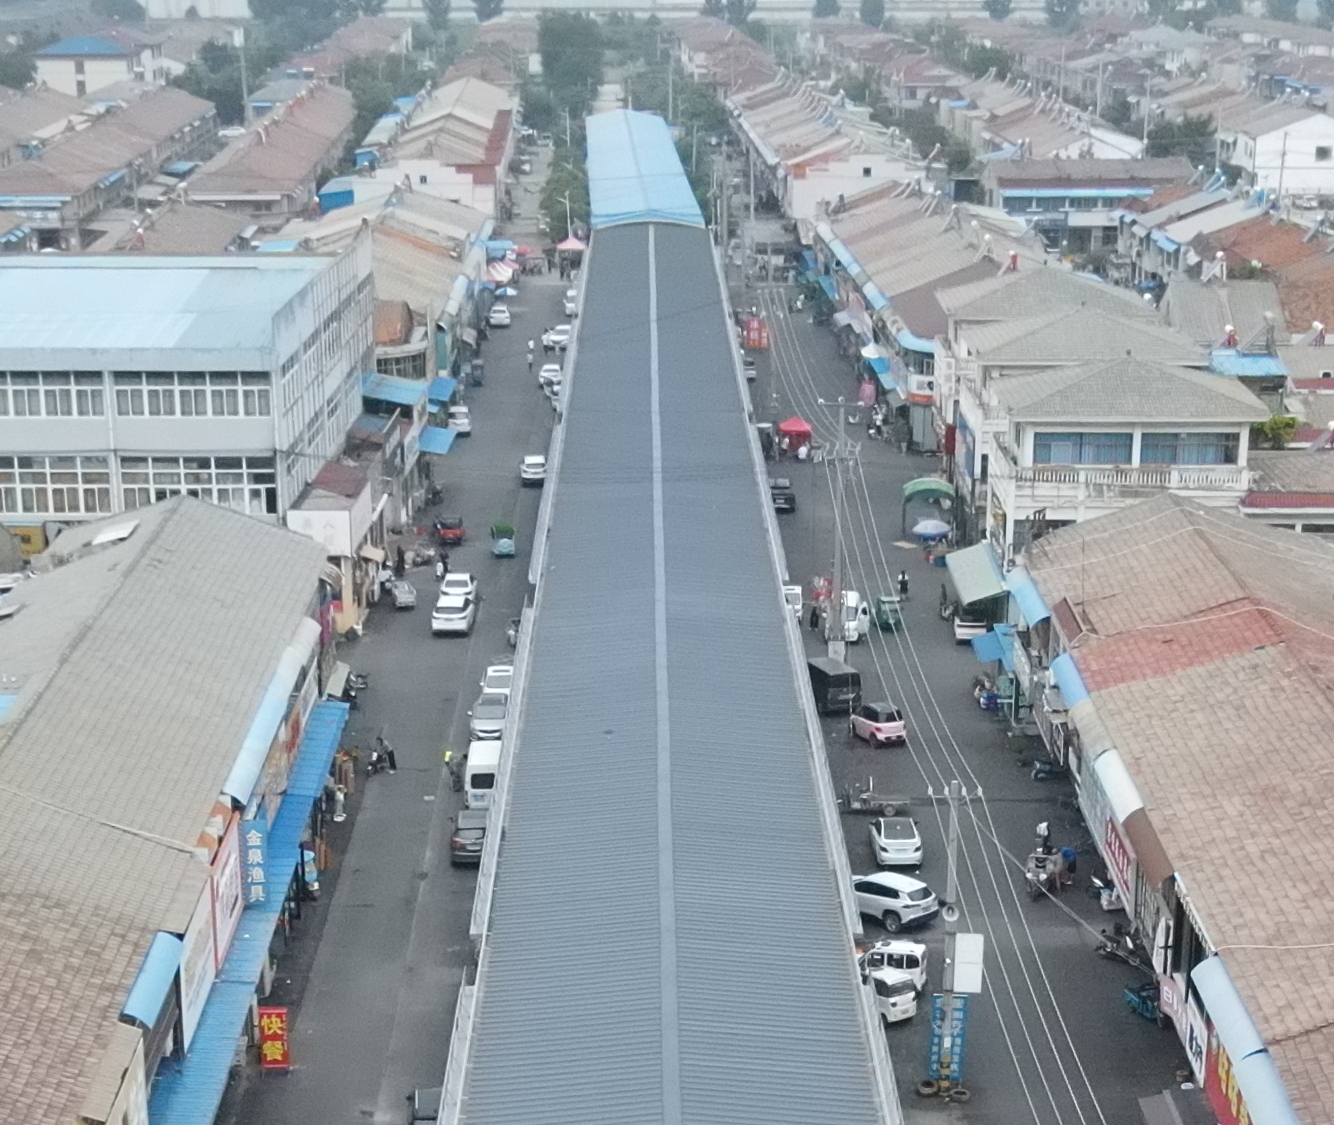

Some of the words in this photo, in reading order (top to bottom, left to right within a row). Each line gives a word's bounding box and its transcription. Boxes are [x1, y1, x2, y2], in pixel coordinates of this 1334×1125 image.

[245, 829, 266, 902] 金泉渔具
[261, 1014, 284, 1061] 快餐
